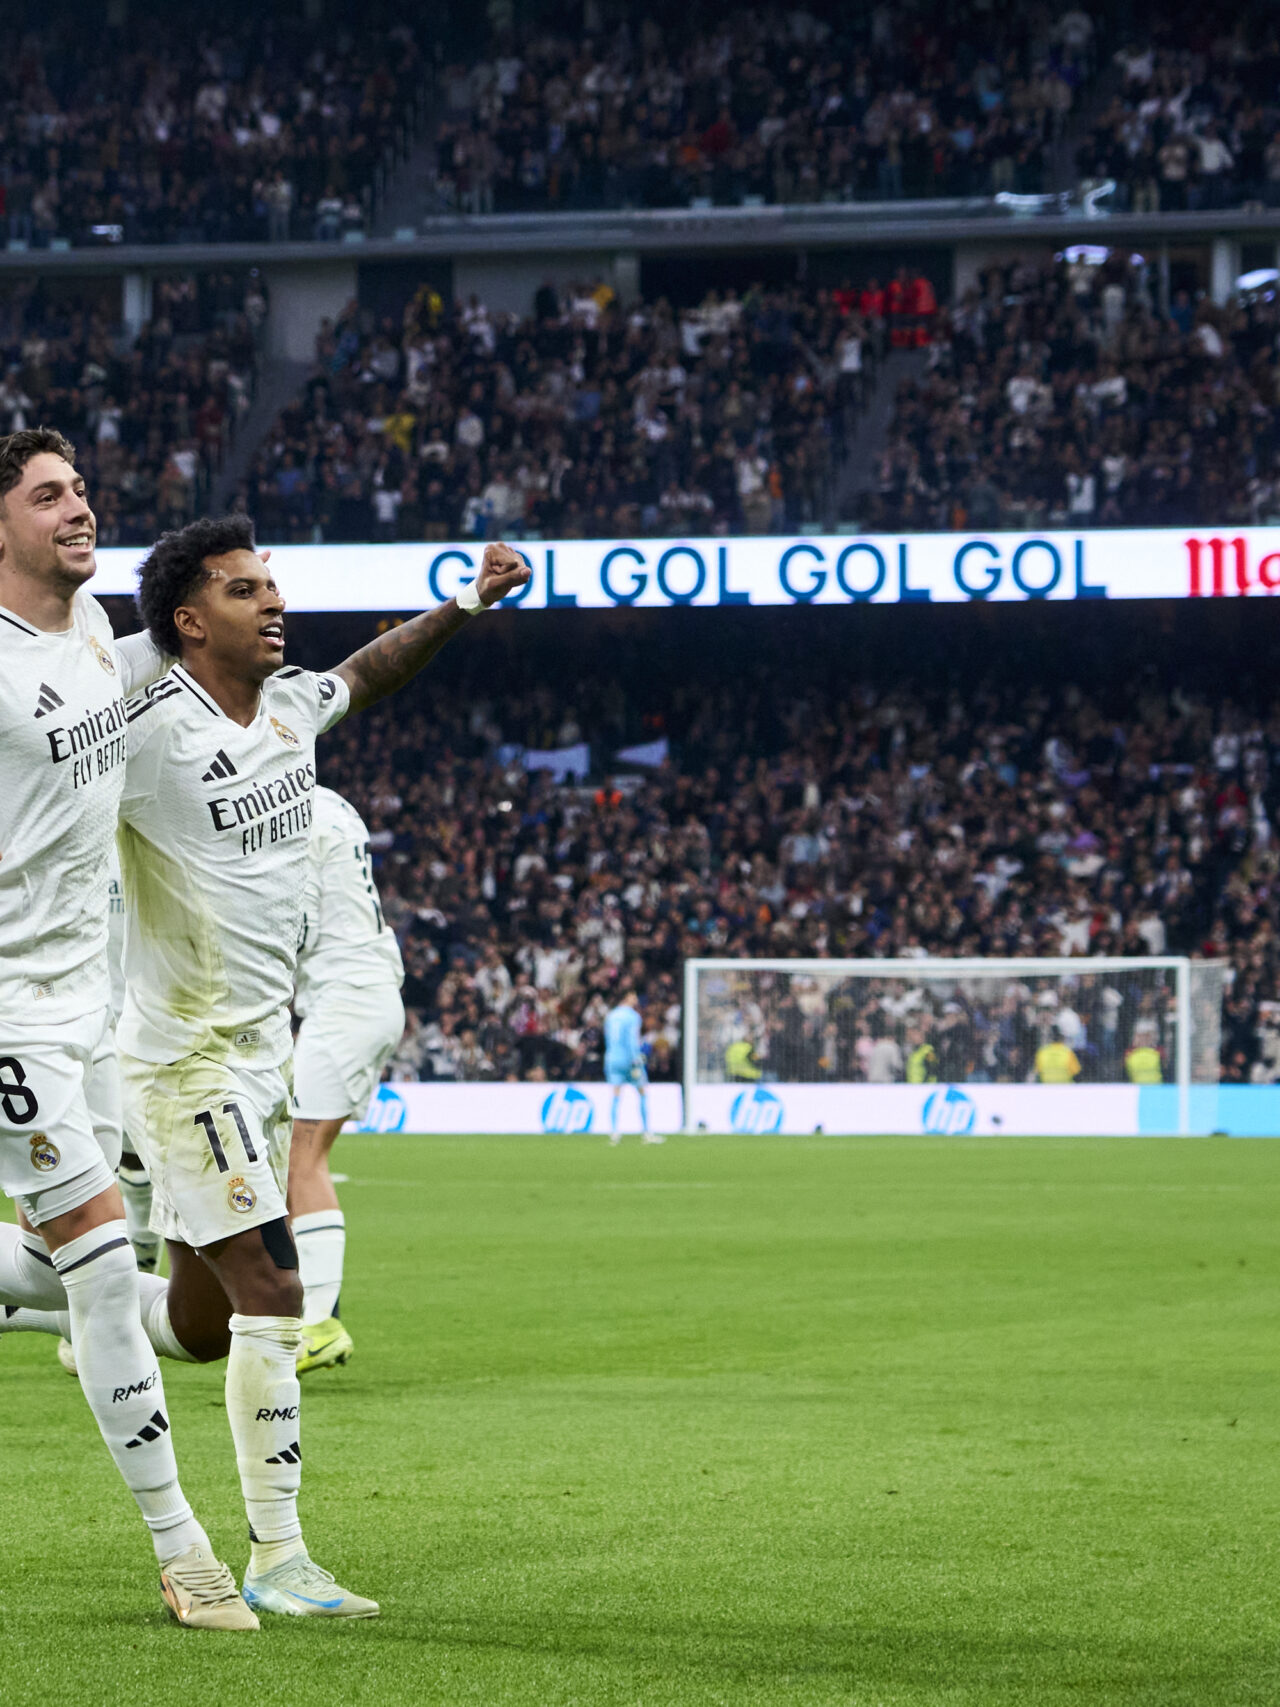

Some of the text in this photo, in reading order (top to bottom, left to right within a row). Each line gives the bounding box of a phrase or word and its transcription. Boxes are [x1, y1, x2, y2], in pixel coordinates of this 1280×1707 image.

[600, 546, 750, 606] GOL
[779, 543, 931, 602] GOL
[953, 539, 1106, 600] GOL
[73, 753, 92, 790] FLY
[207, 763, 315, 832] Emirates
[242, 798, 313, 856] FLY BETTER
[542, 1085, 594, 1132] hp
[731, 1086, 784, 1133] hp
[923, 1086, 975, 1133] hp
[194, 1103, 258, 1174] 11
